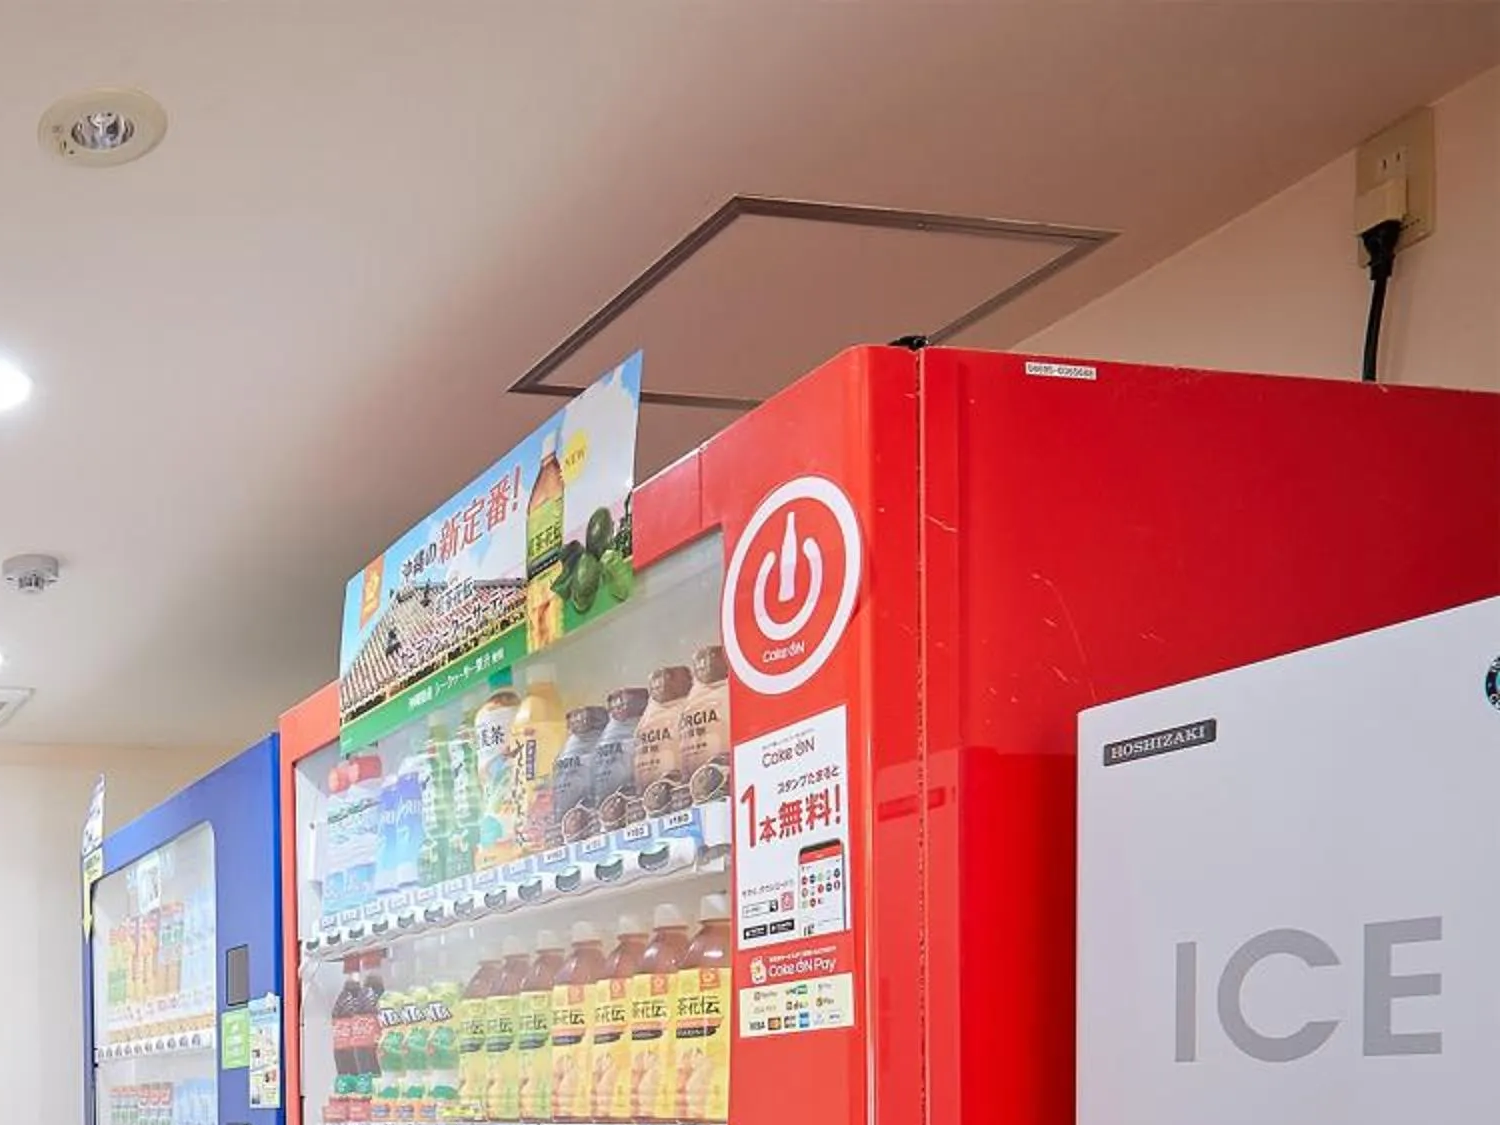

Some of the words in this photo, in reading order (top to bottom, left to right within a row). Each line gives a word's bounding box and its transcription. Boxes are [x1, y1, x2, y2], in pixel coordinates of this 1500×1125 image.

[1111, 724, 1206, 761] HOSHIZAKI
[740, 783, 842, 848] 1本無料!
[1174, 915, 1442, 1063] ICE
